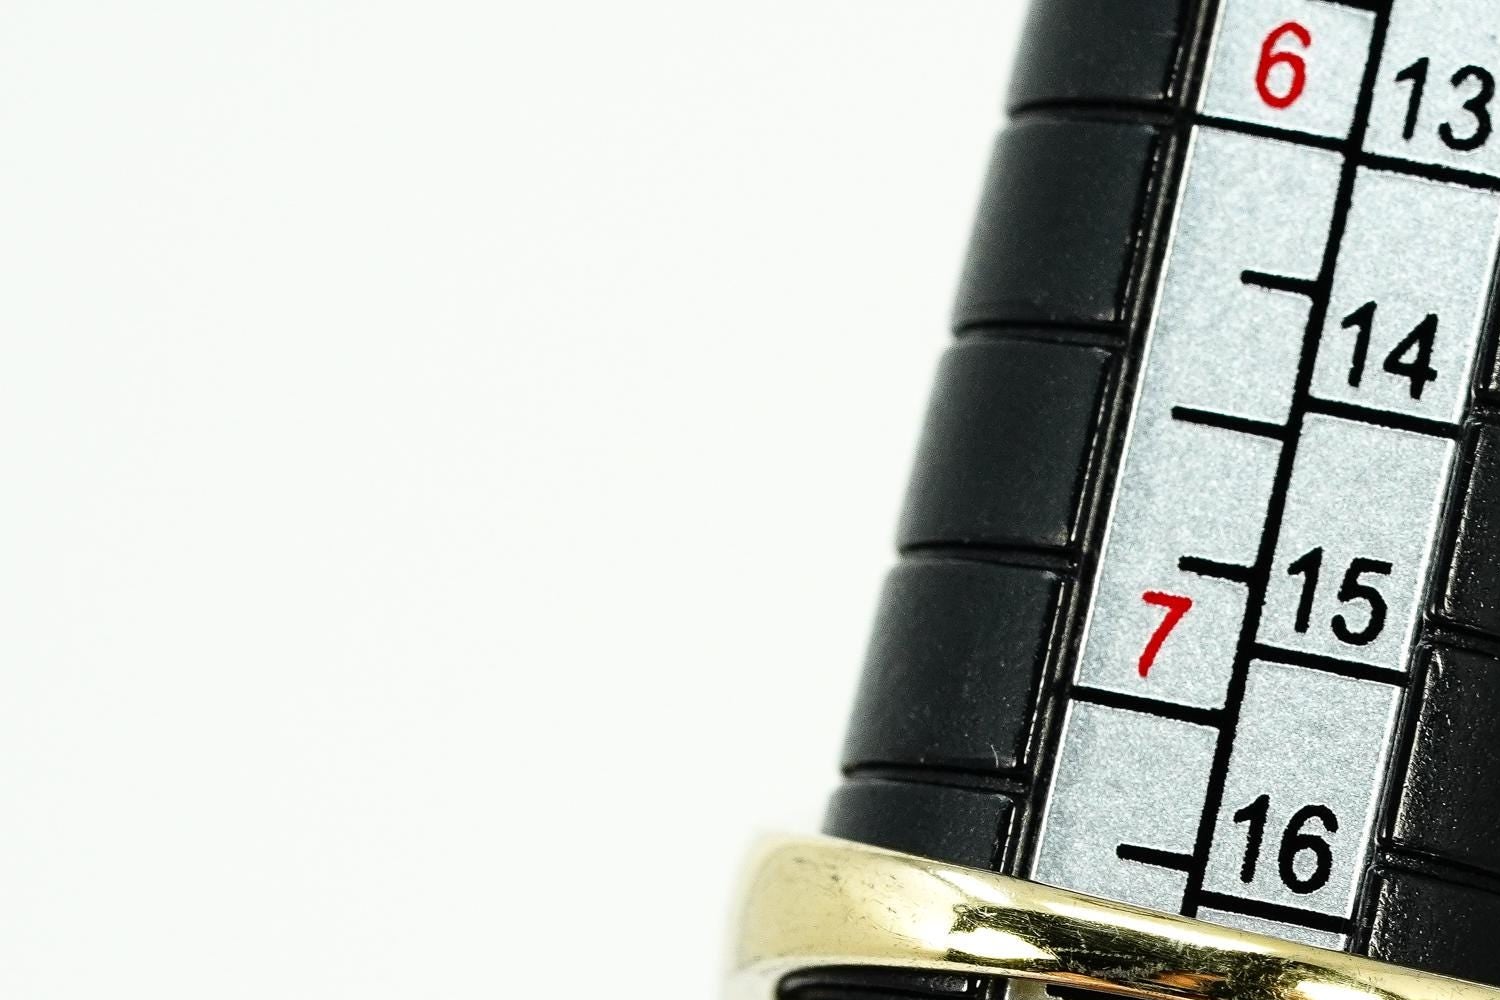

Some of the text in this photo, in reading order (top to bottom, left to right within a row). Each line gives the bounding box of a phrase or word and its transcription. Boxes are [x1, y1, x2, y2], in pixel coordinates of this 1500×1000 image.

[1254, 20, 1313, 110] 6
[1394, 56, 1497, 152] 13
[1340, 300, 1439, 401] 14
[1138, 590, 1193, 678] 7
[1286, 546, 1394, 647] 15
[1232, 793, 1339, 895] 16
